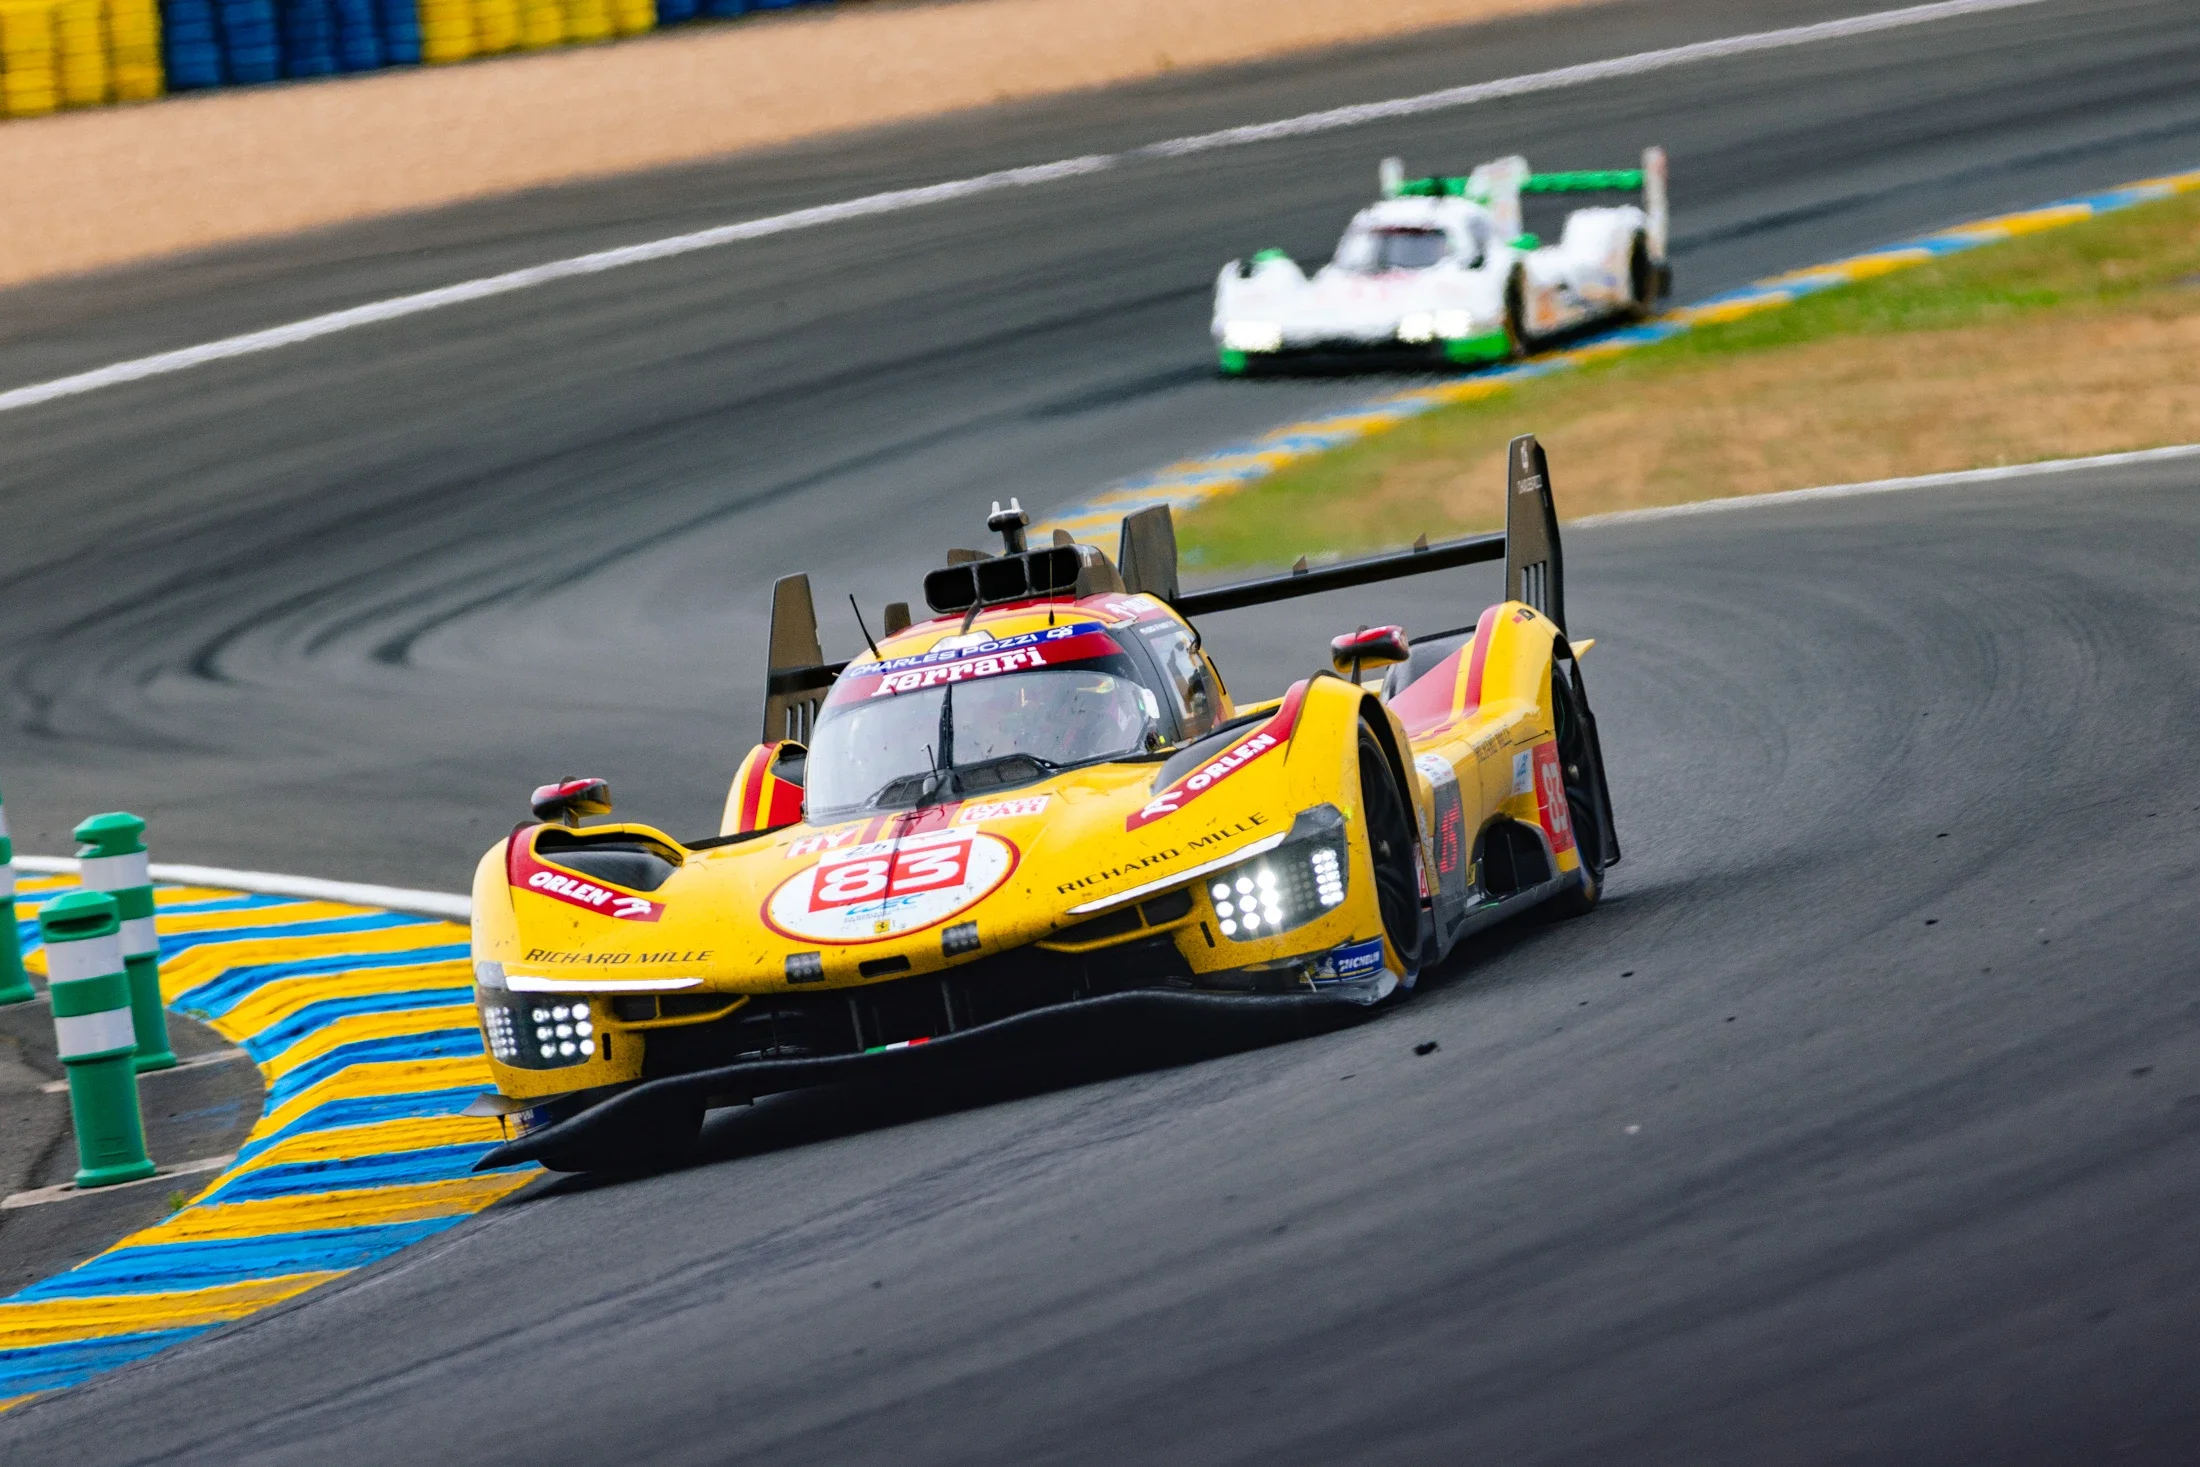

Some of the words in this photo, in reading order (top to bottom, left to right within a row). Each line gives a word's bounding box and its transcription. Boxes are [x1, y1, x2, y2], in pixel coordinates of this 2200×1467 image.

[849, 650, 957, 678] CHARLES
[962, 633, 1037, 657] POZZI
[871, 647, 1047, 696] Ferrari
[1186, 733, 1277, 790] ORLEN
[818, 845, 962, 902] 83
[1056, 848, 1181, 895] RICHARD
[1187, 812, 1269, 850] MILLE
[528, 871, 614, 906] ORLEN
[524, 948, 633, 964] RICHARD
[634, 950, 715, 963] MILLE
